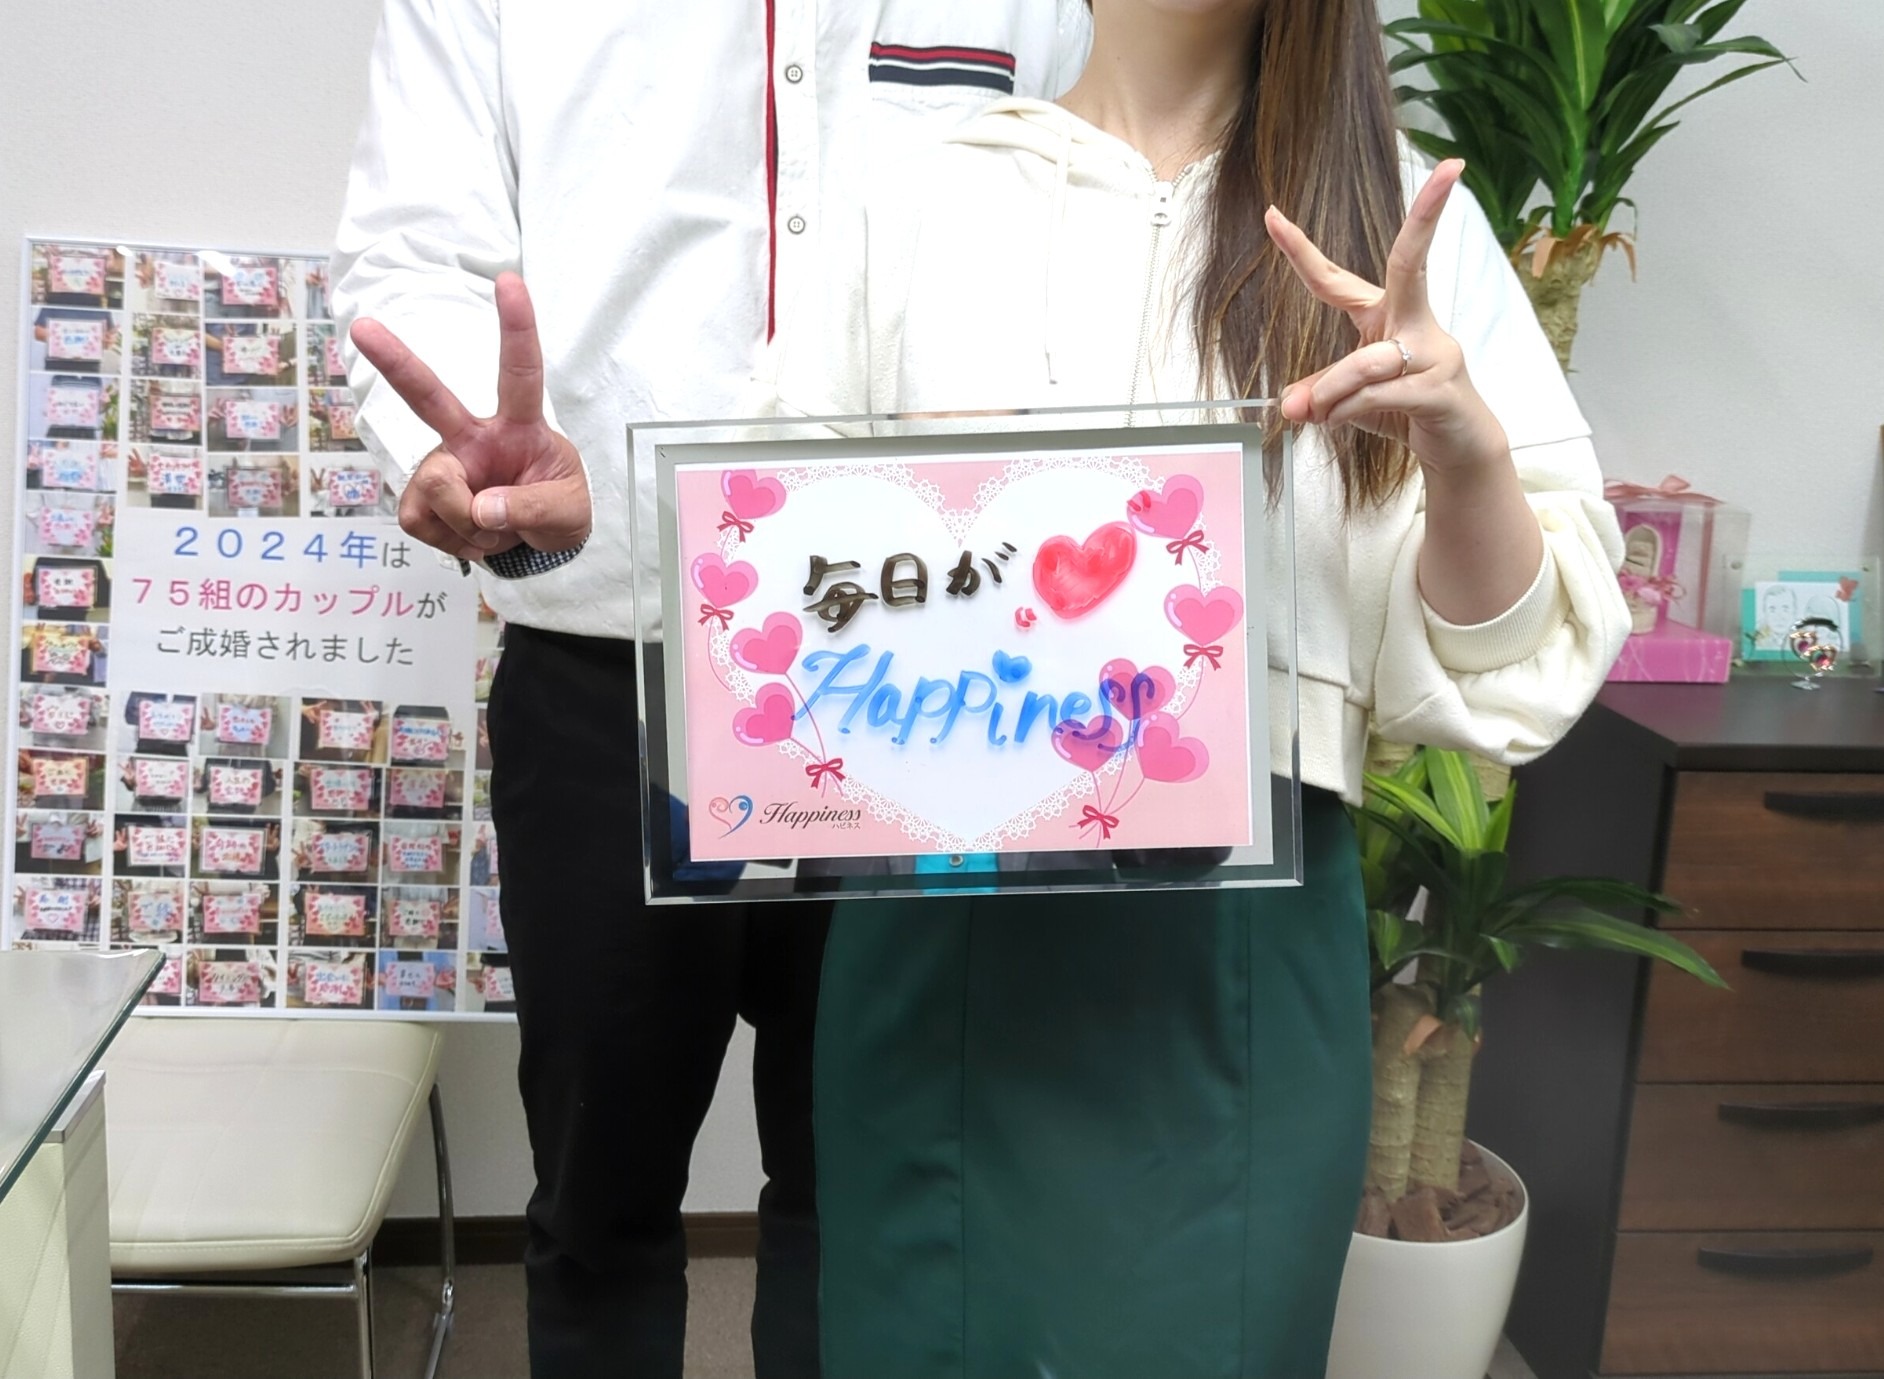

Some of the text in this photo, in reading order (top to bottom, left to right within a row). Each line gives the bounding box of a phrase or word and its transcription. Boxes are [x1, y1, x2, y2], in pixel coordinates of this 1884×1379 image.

[173, 526, 411, 568] 2024年は
[132, 578, 448, 619] 75組のカップルが
[803, 542, 1017, 634] 毎日が
[157, 626, 414, 665] ご成婚されました
[790, 644, 1156, 752] Happiness
[760, 801, 861, 829] Happiness
